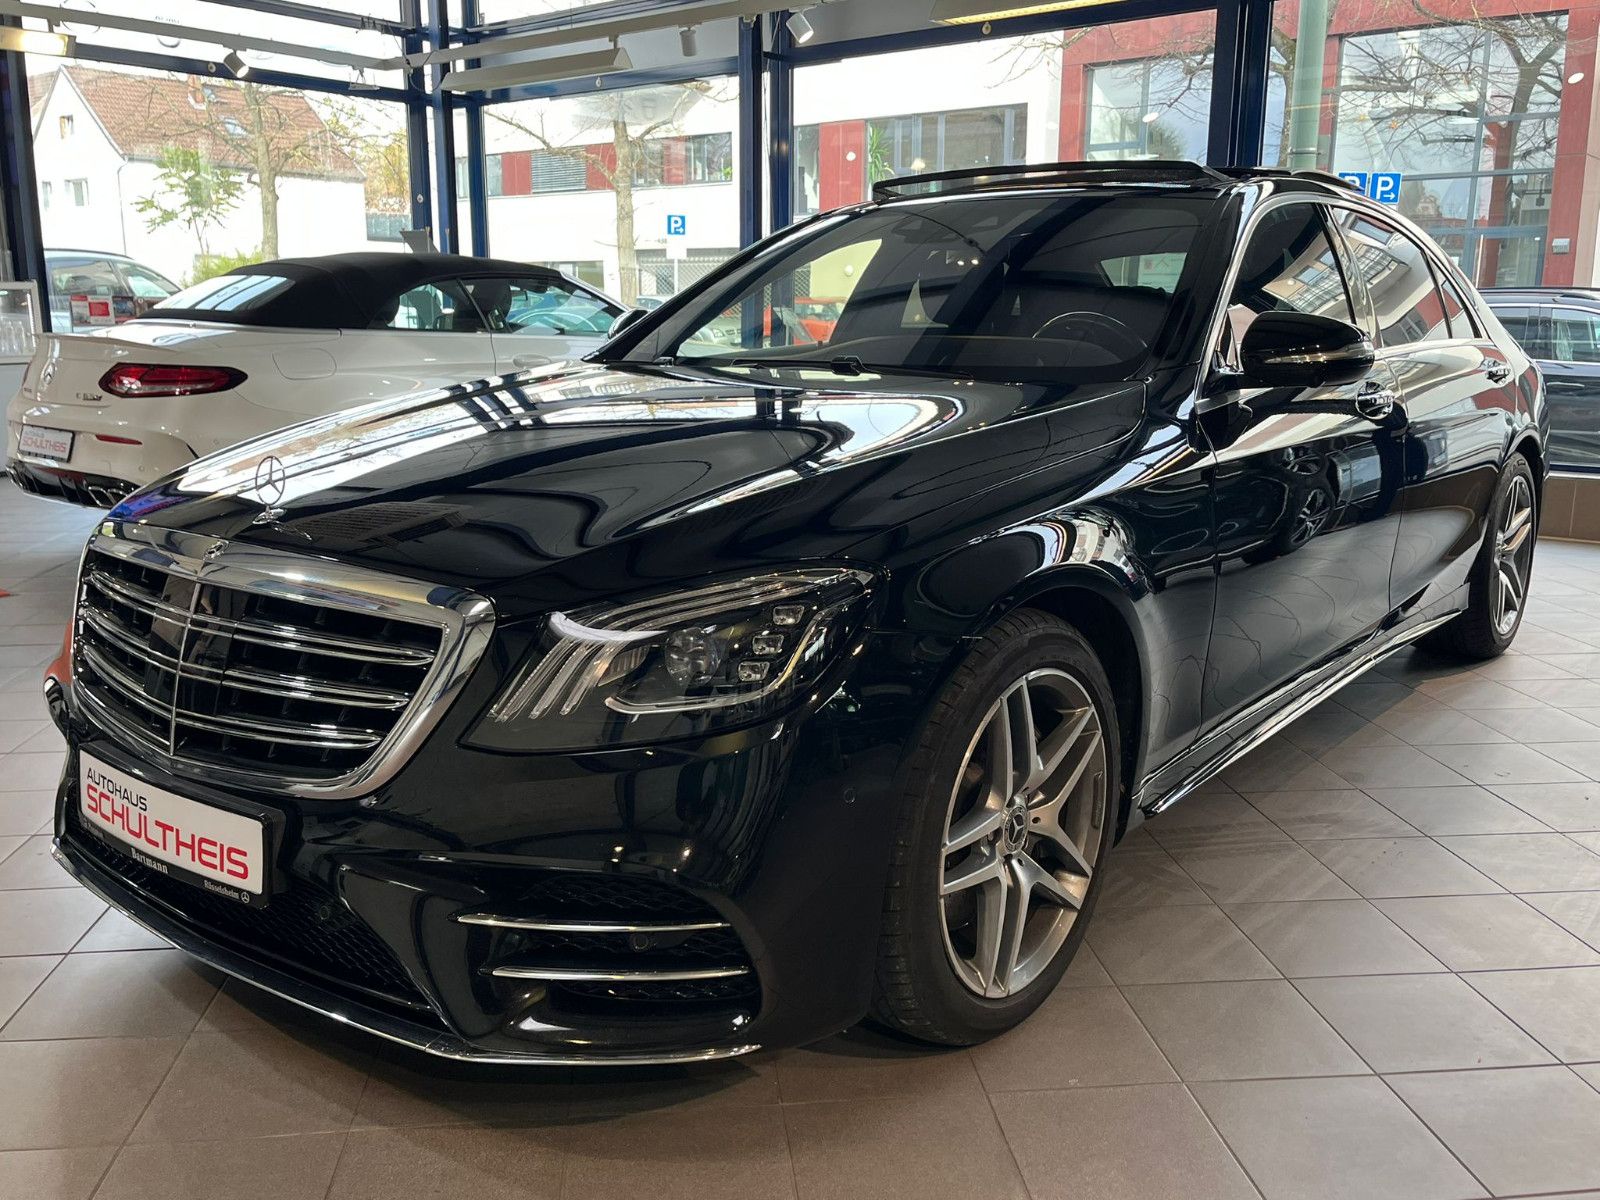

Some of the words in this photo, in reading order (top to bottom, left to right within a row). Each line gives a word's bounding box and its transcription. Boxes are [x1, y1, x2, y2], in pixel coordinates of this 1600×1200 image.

[1375, 176, 1394, 200] P
[670, 216, 682, 234] P
[87, 767, 148, 812] AUTOHAUS
[86, 783, 249, 880] SCHULTHEIS
